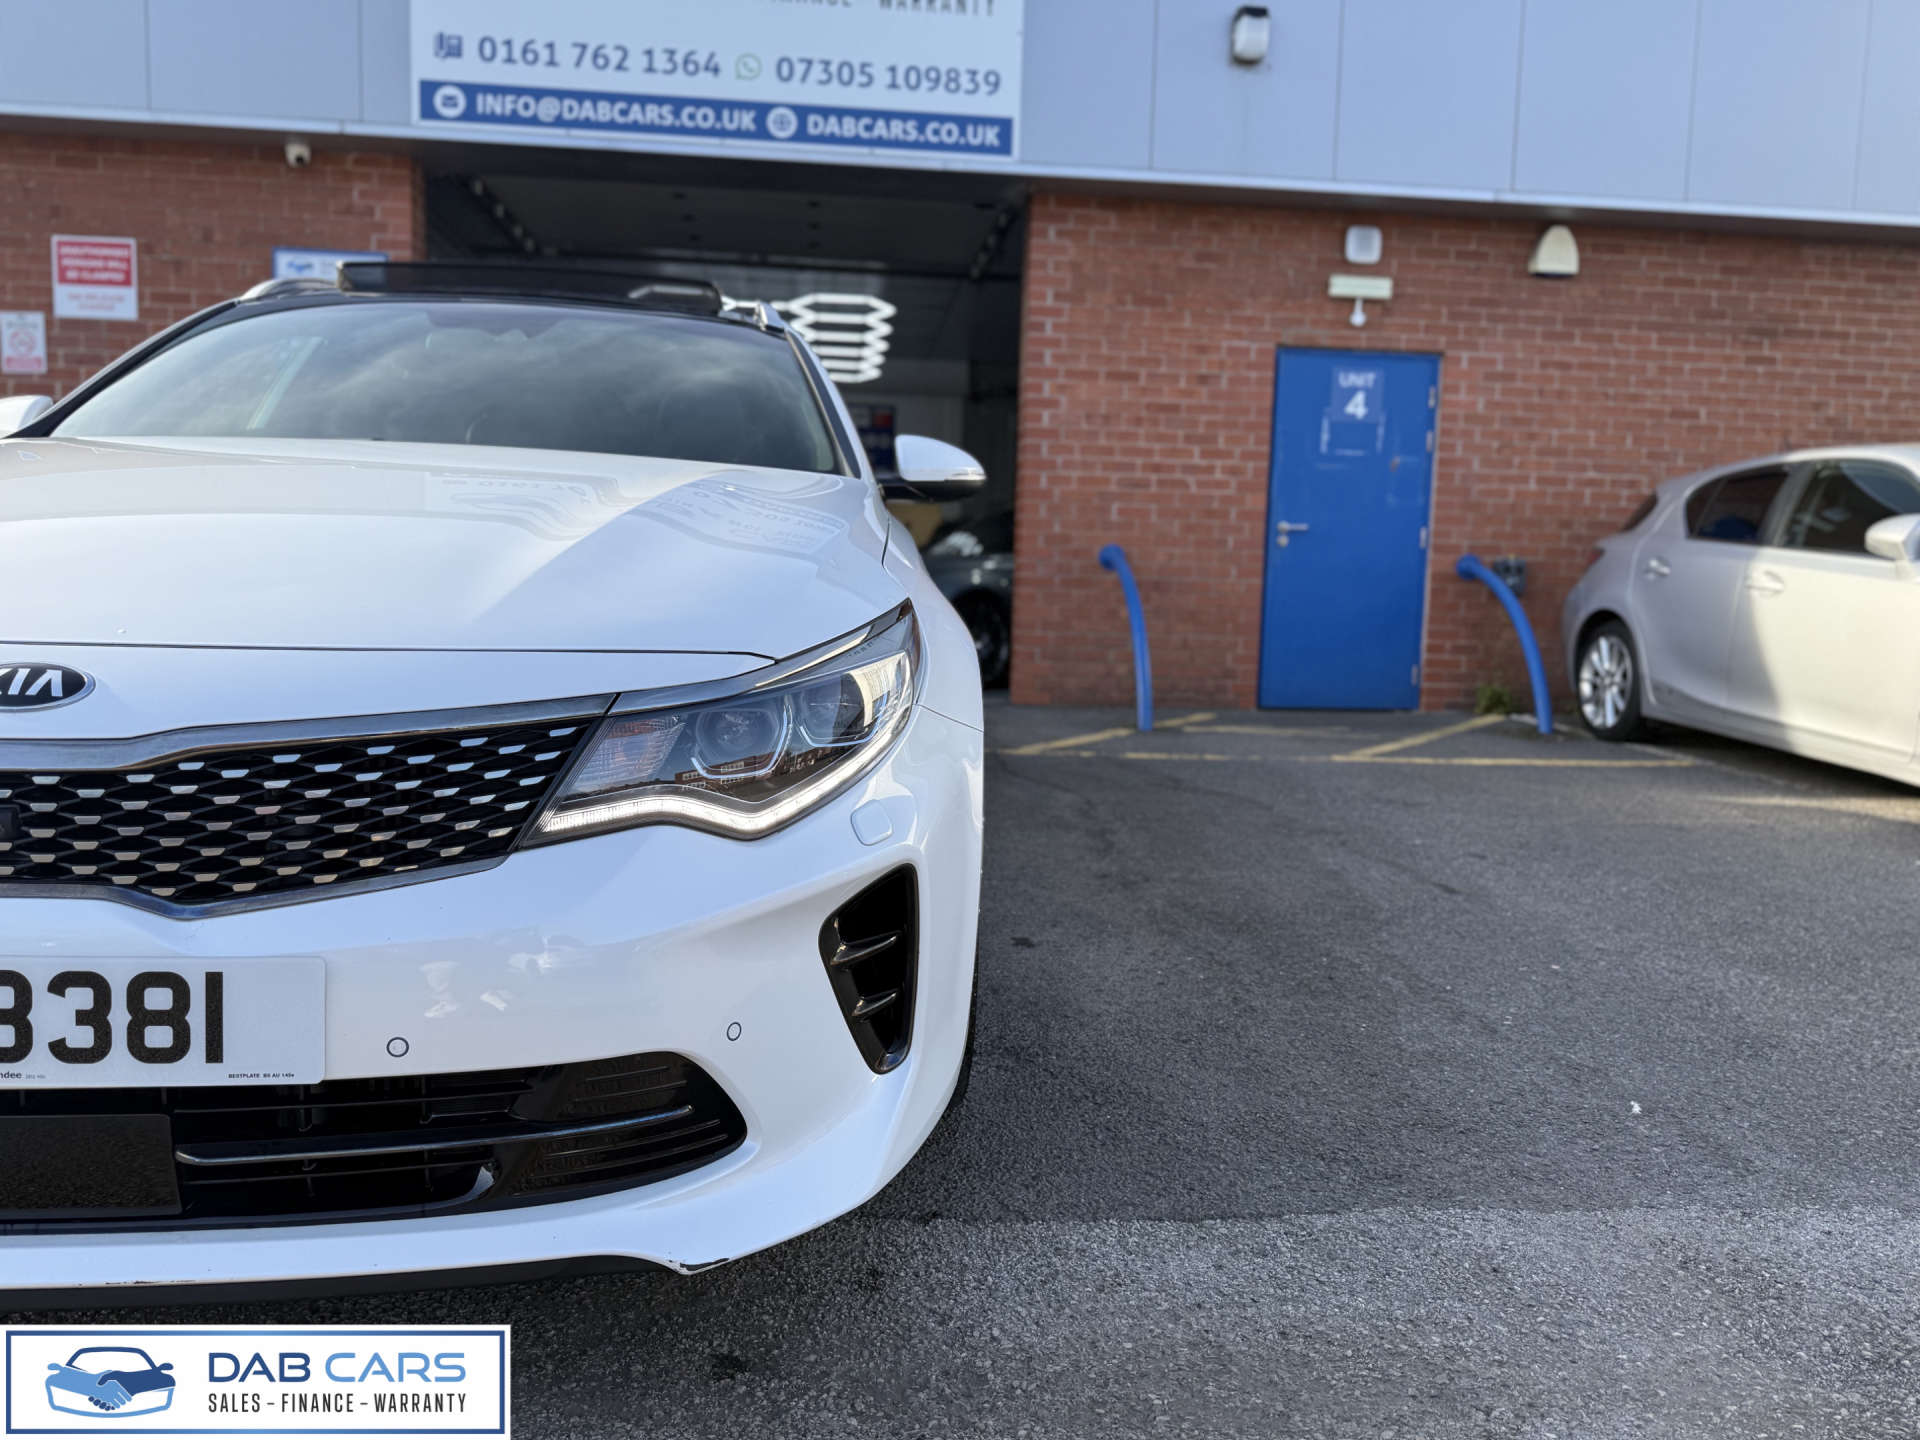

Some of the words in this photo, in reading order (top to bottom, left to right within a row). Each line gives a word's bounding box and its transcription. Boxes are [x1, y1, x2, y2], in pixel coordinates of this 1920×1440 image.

[477, 35, 560, 67] 0161
[571, 42, 630, 73] 762
[642, 47, 721, 77] 1364
[775, 56, 874, 89] 07305
[886, 64, 1002, 96] 109839
[475, 92, 757, 132] INFO@DABCARS.CO.UK
[806, 113, 1001, 147] DABCARS.CO.UK
[1338, 371, 1376, 388] UNIT
[1343, 389, 1368, 420] 4
